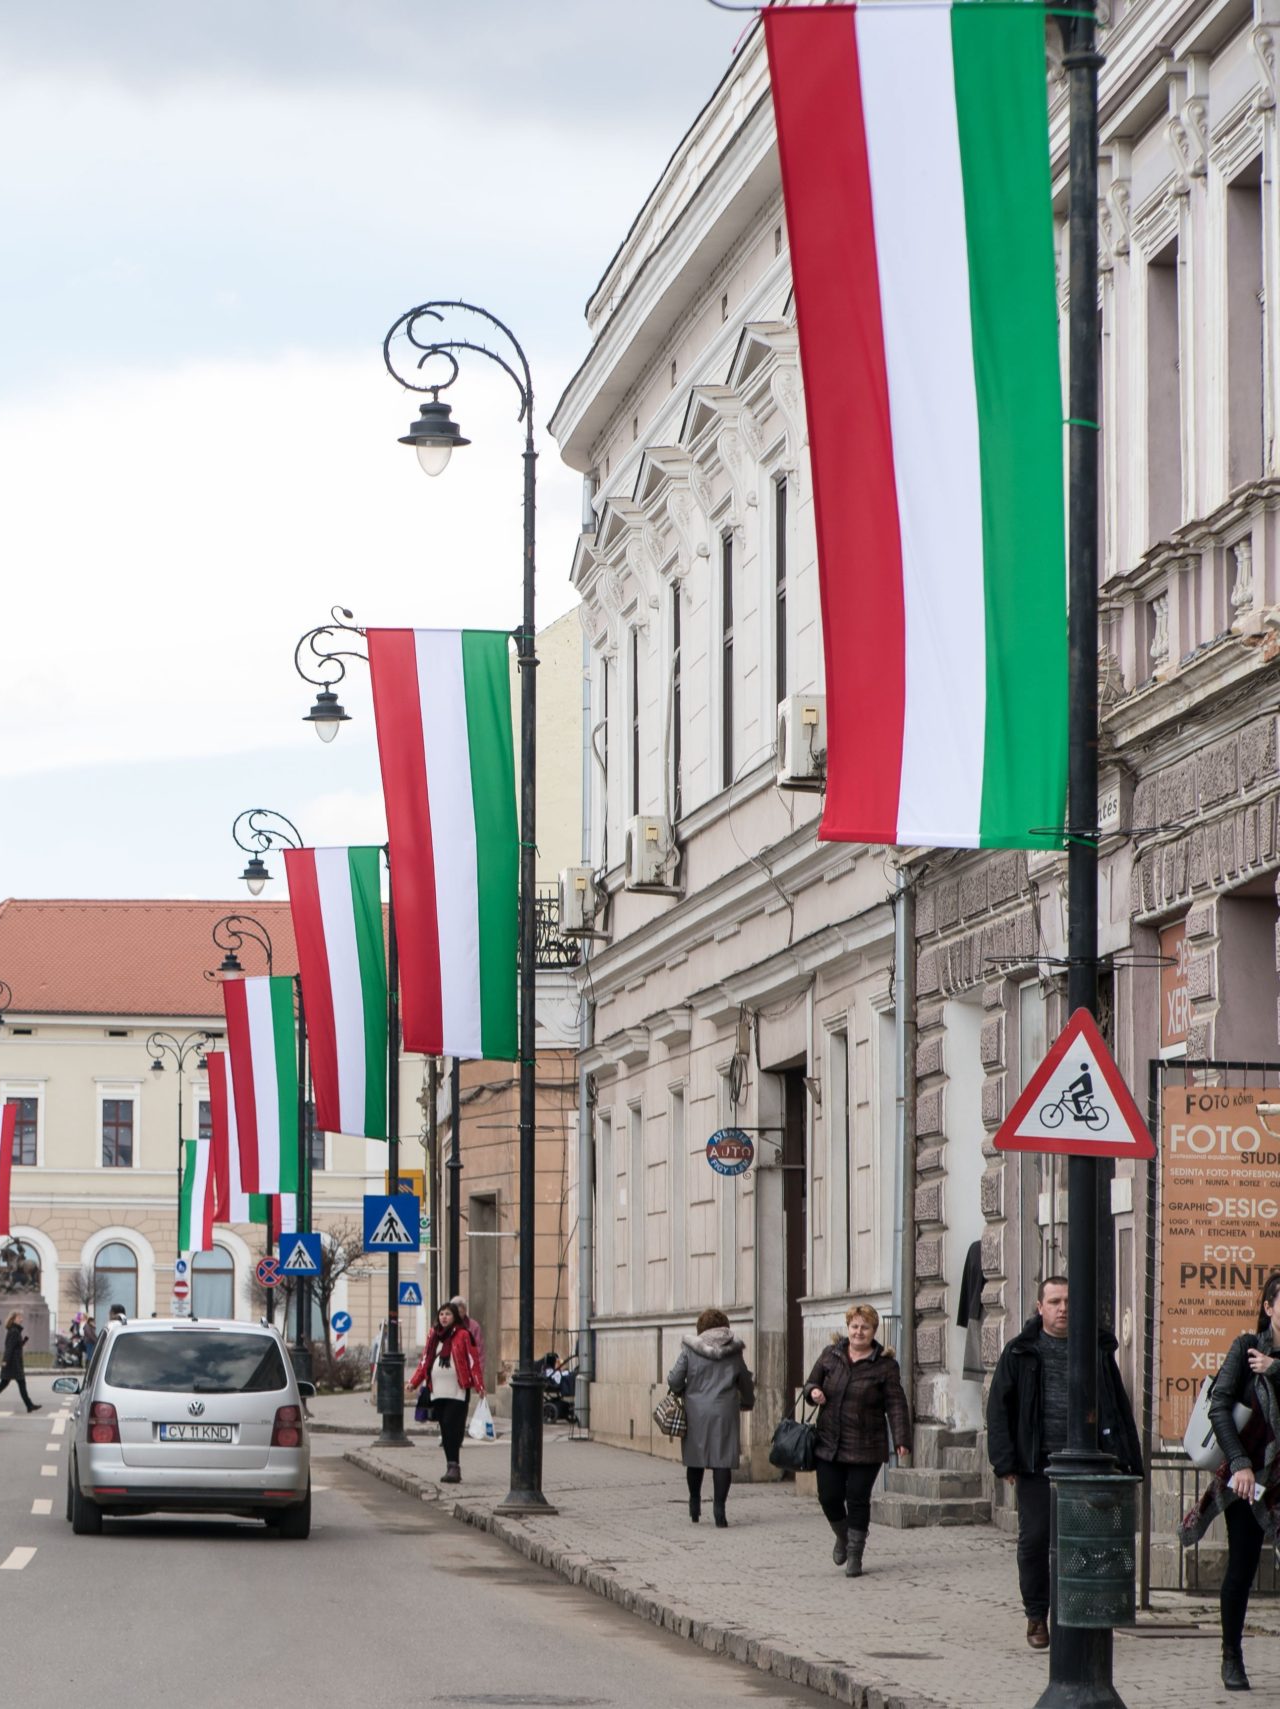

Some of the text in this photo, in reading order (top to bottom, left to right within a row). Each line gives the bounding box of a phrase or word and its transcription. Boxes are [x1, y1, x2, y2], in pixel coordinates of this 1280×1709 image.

[1186, 1094, 1230, 1115] FOTO
[1170, 1124, 1261, 1154] FOTO
[710, 1146, 751, 1158] AUTO
[1241, 1151, 1280, 1165] STUDI
[1170, 1168, 1204, 1177] SEDINTA
[1206, 1168, 1229, 1177] FOTO
[1206, 1179, 1229, 1187] NUNTA
[1169, 1197, 1279, 1219] GRAPHIC DESIG
[1169, 1227, 1195, 1236] MAPA
[1208, 1228, 1247, 1237] ETICHETA
[1204, 1244, 1256, 1263] FOTO
[1215, 1299, 1246, 1307] BANNER
[1198, 1308, 1234, 1317] ARTICOLE
[1180, 1327, 1226, 1336] SERIGRAFIE
[1180, 1337, 1210, 1346] CUTTER
[168, 1425, 228, 1439] CV 11 KND
